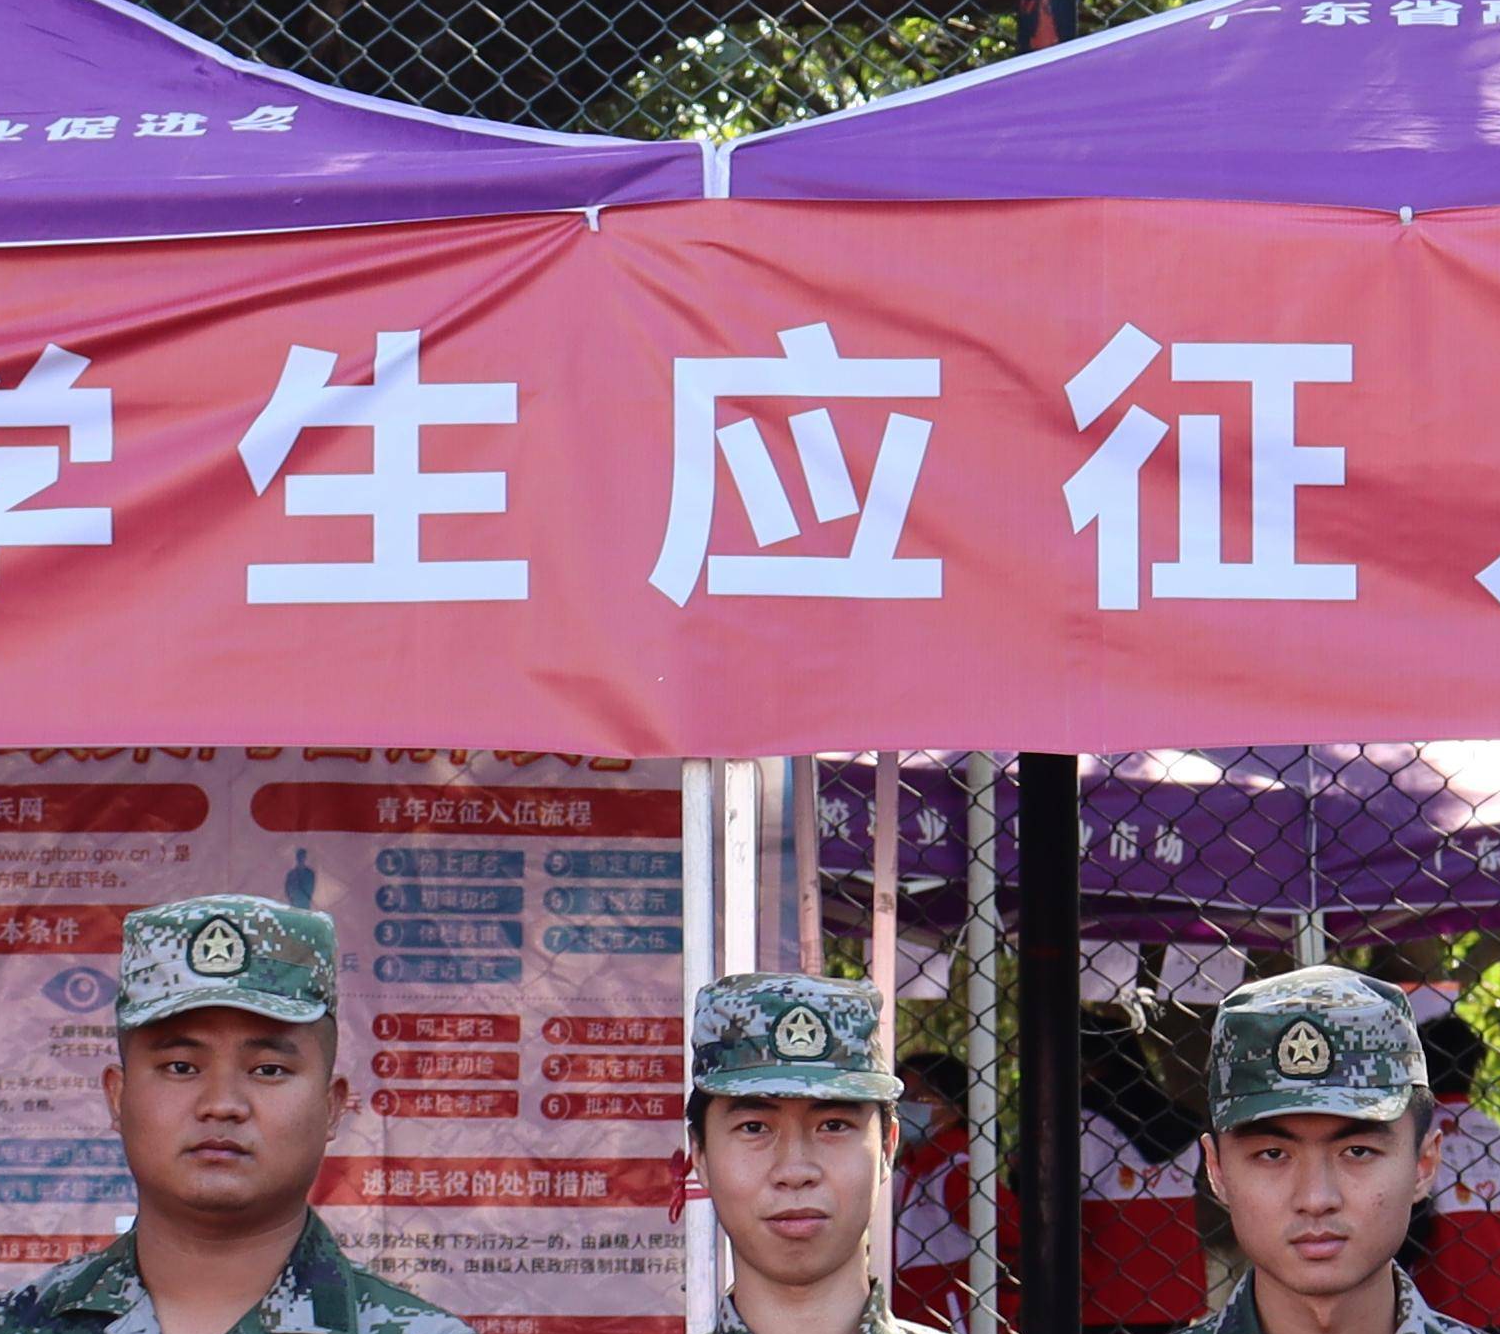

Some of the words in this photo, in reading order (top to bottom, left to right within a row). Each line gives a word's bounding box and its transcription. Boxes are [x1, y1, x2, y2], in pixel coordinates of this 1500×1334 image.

[376, 796, 593, 826] 青年应征入伍流程
[415, 1020, 495, 1038] 网上报名
[416, 1056, 495, 1075] 初审初检
[586, 1059, 666, 1078] 预定新兵
[585, 1097, 665, 1116] 批准入伍
[362, 1169, 608, 1198] 逃避兵役的处罚措施
